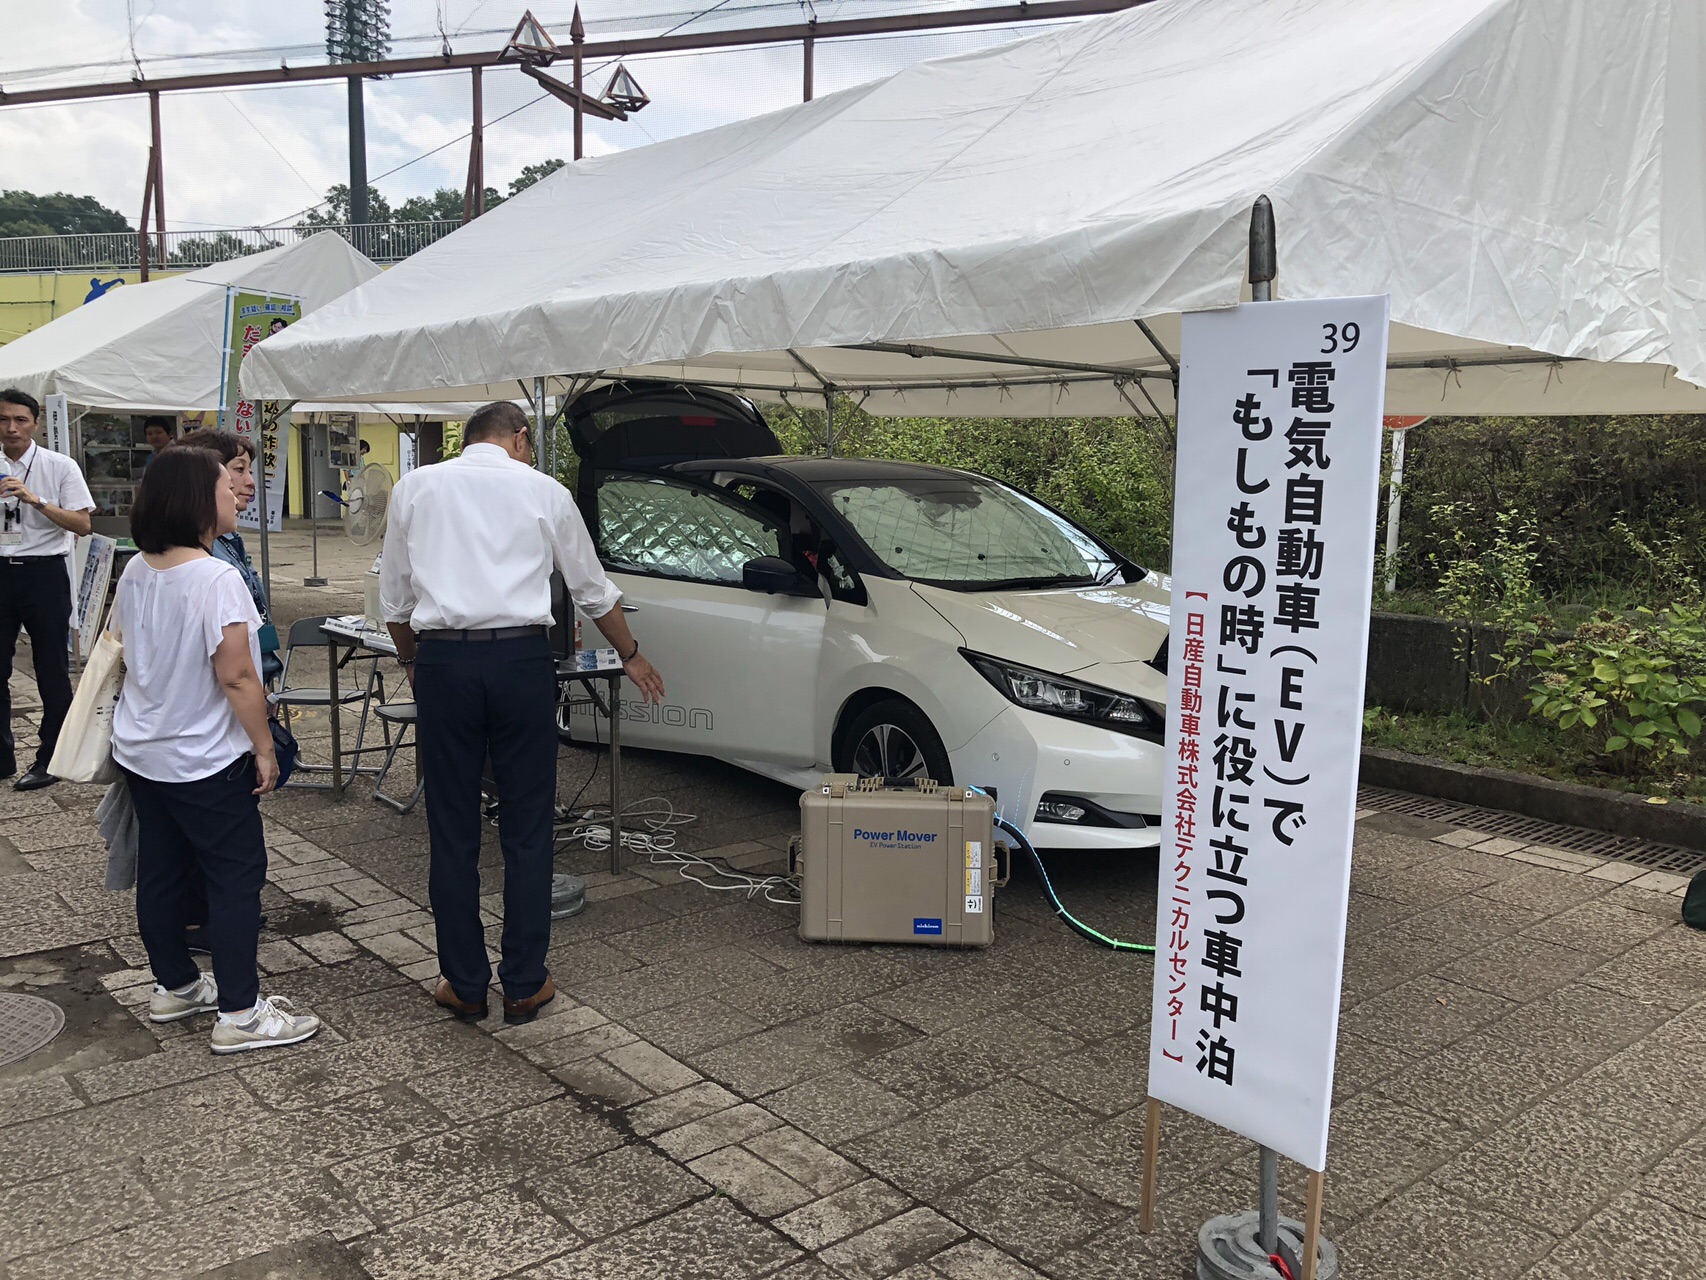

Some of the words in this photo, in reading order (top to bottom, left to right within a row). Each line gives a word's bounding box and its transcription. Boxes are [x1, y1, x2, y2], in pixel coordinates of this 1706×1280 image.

[1320, 321, 1361, 354] 39
[854, 828, 895, 841] Power
[896, 829, 938, 842] Mover
[1162, 590, 1208, 1064] 【日産自動車株式会社テクニカルセンター】
[1195, 368, 1279, 1087] 「もしもの時」に役に立つ車中泊
[1263, 361, 1336, 847] 電気自動車（EV）で
